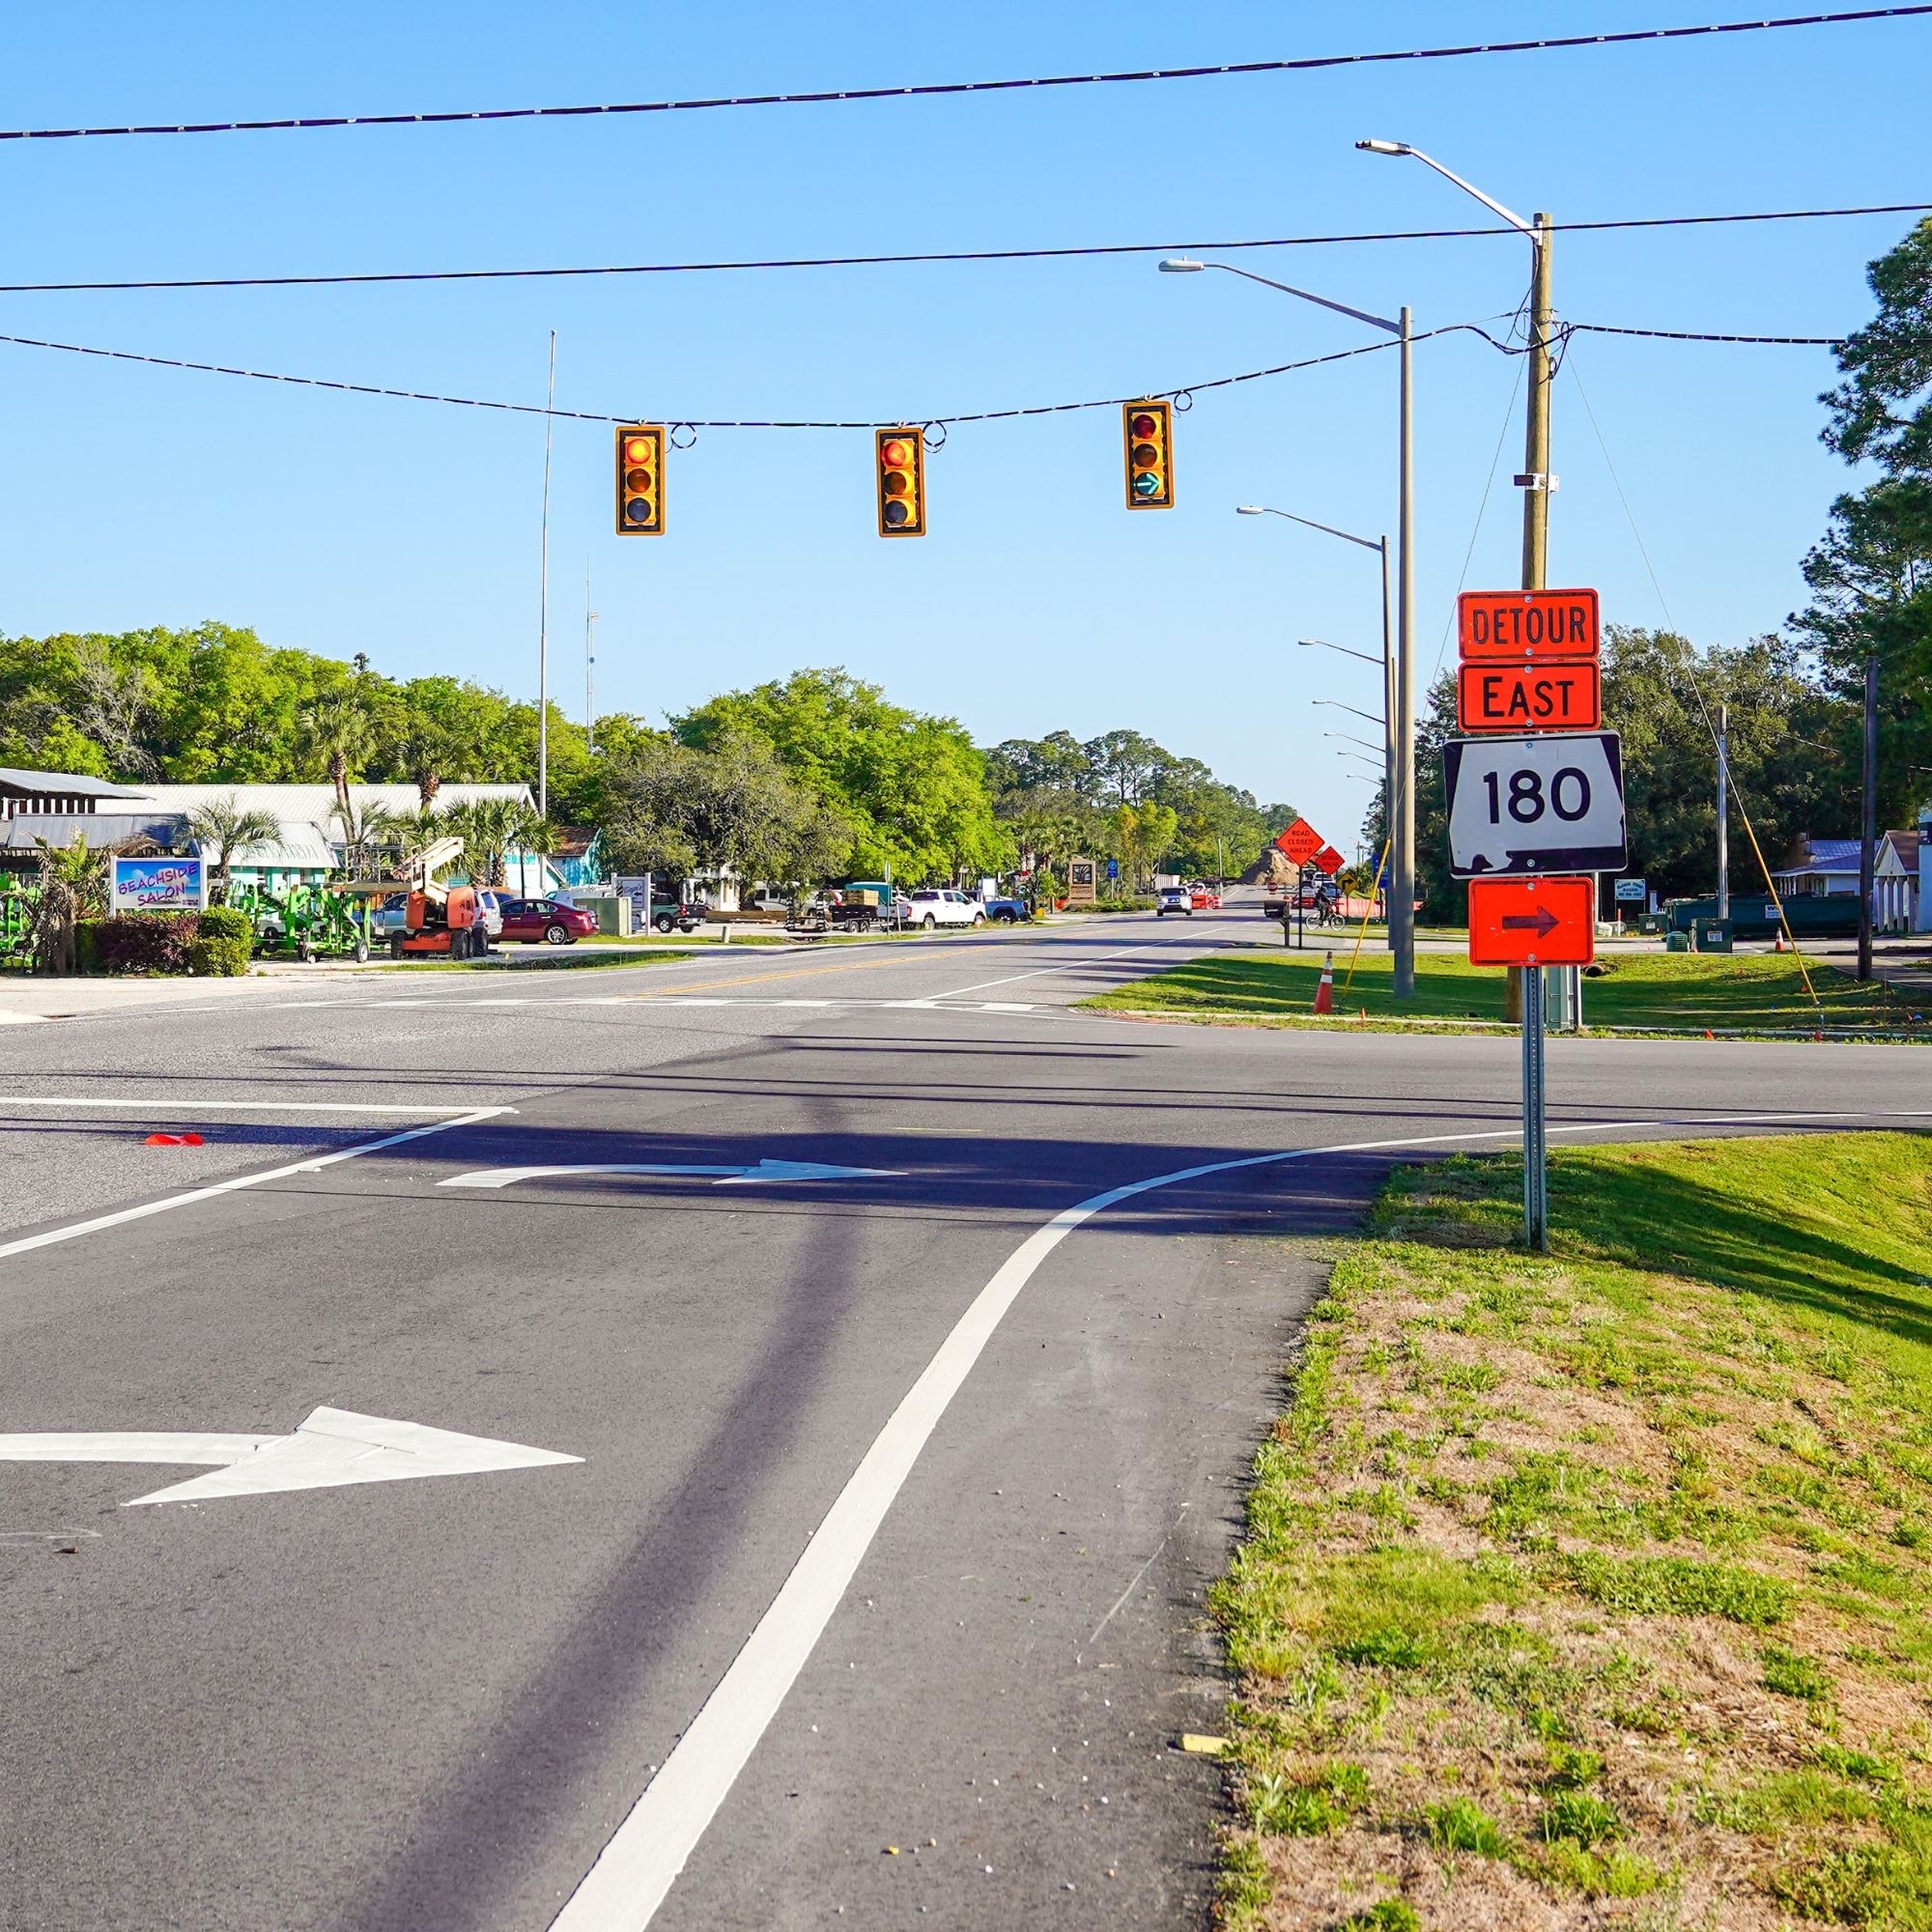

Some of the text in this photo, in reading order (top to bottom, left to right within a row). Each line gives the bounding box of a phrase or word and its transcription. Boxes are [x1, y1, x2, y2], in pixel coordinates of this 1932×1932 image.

[1472, 606, 1586, 644] DETOUR
[1483, 676, 1575, 717] EAST
[1483, 767, 1591, 824] 180
[118, 863, 198, 895] BEACHSIDE
[137, 882, 185, 906] SALON
